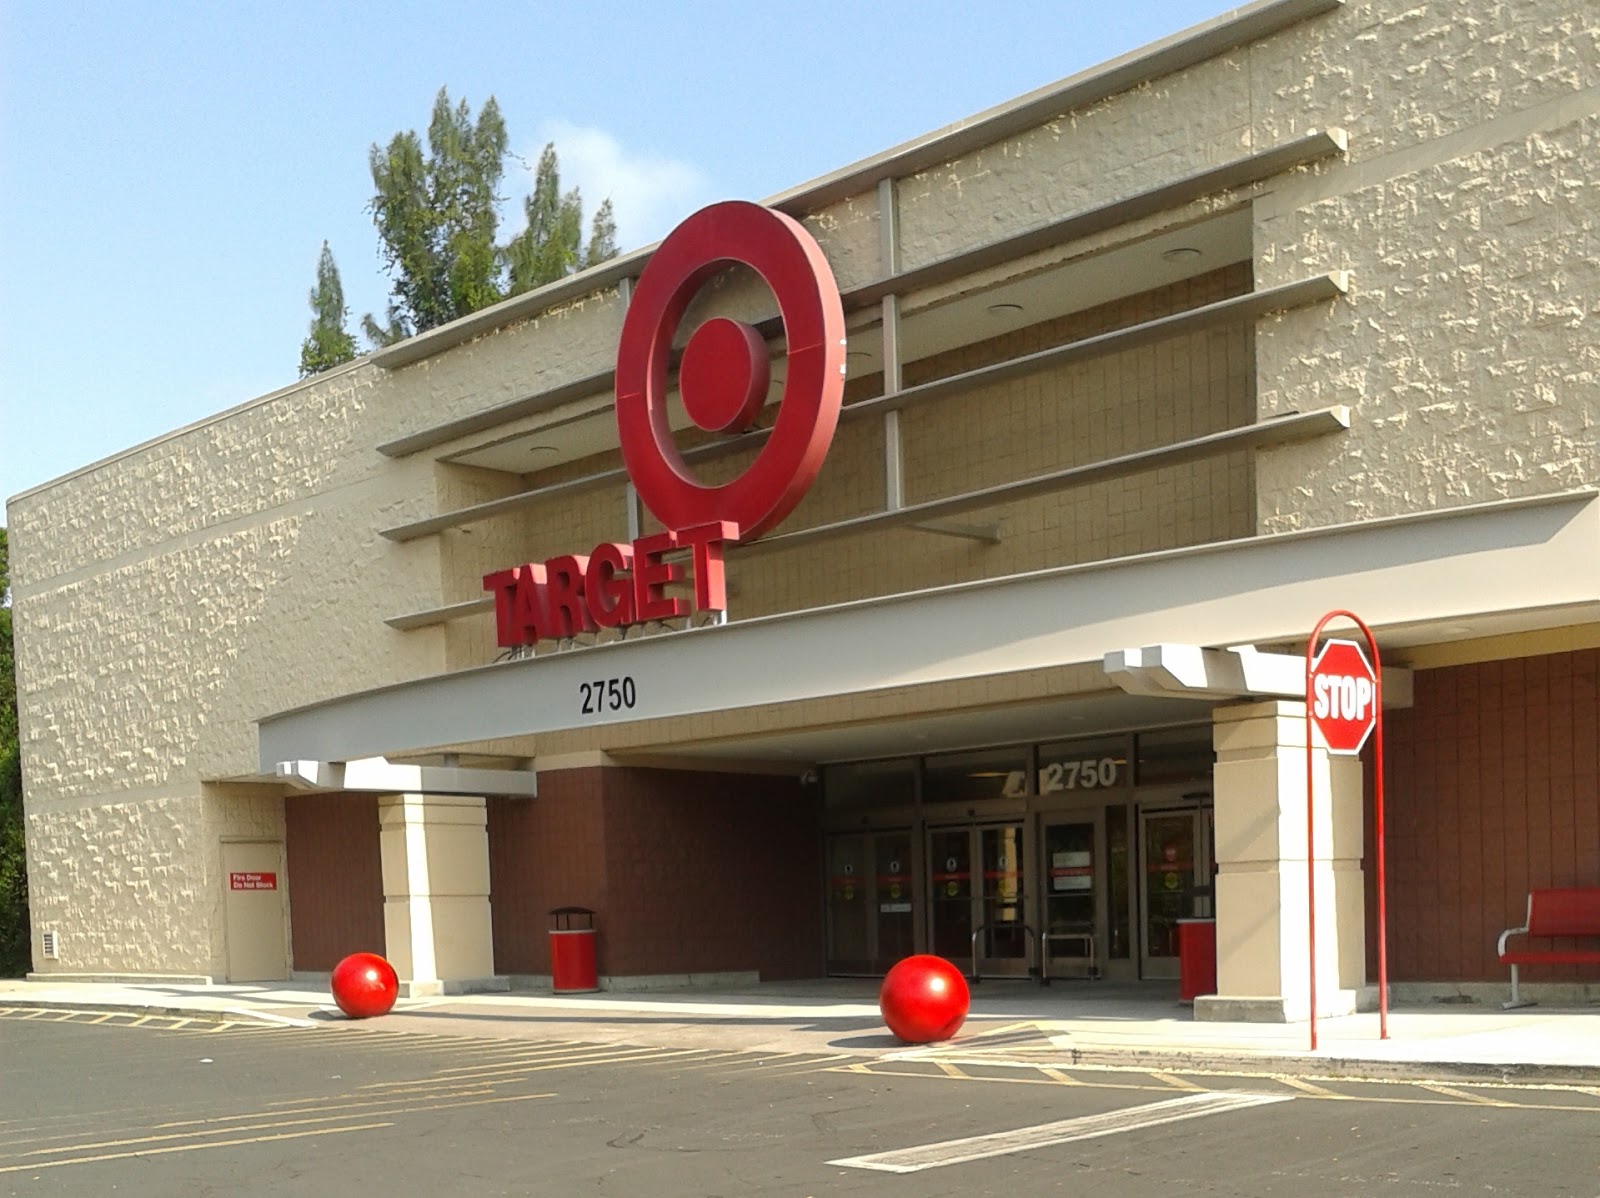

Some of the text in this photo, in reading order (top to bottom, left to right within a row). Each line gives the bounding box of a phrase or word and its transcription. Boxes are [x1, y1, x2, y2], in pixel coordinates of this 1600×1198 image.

[483, 520, 739, 647] TARGET
[580, 676, 636, 714] 2750
[1314, 673, 1372, 721] STOP
[1046, 757, 1117, 791] 2750
